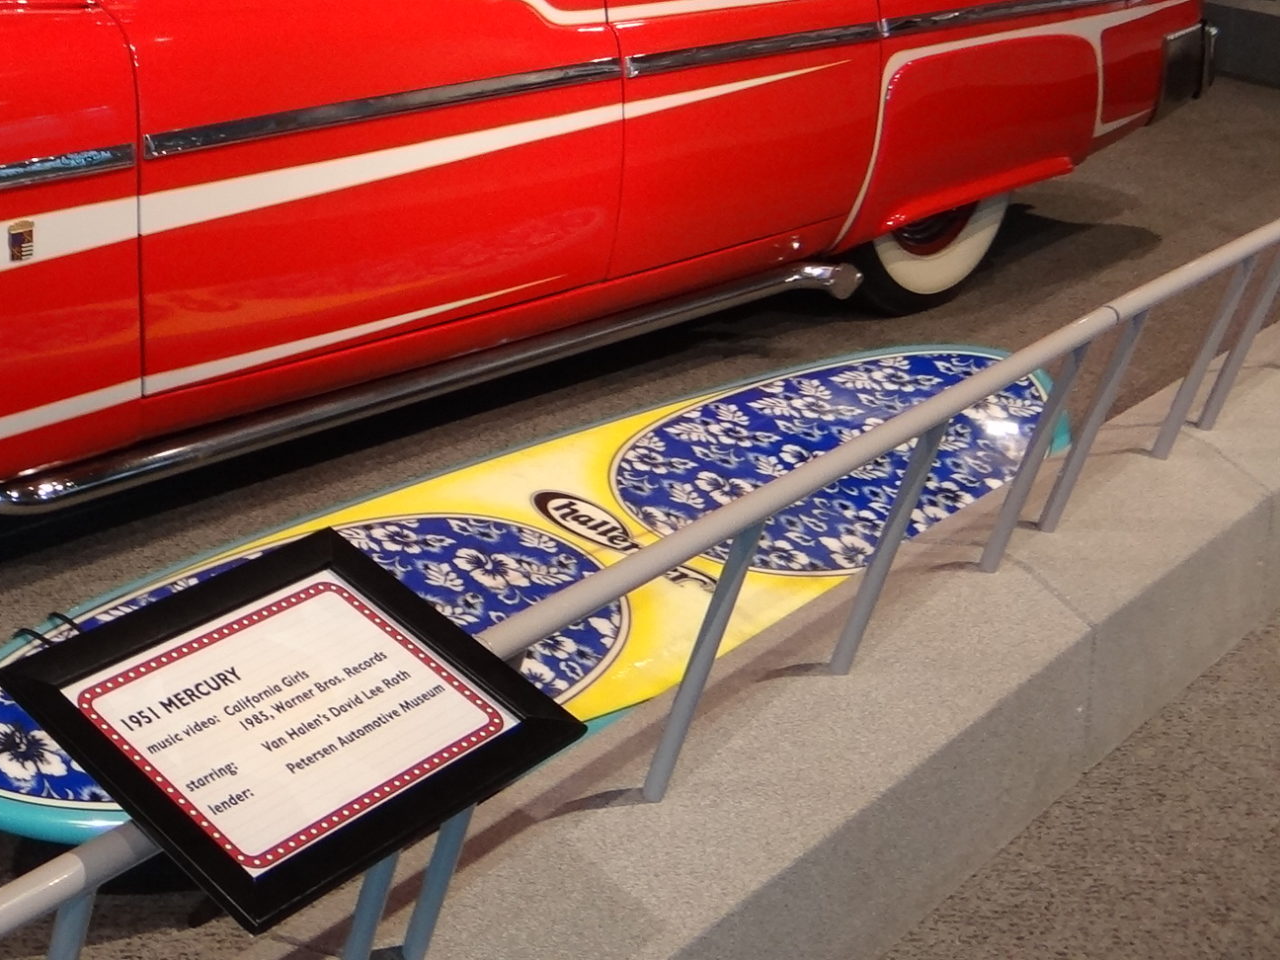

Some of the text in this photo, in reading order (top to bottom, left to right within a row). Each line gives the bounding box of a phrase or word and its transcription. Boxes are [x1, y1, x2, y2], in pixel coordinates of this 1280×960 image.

[120, 666, 242, 732] 1951 MERCURY
[146, 670, 310, 755] music video: California Girls
[185, 669, 412, 792] starring: Van Halen's David Lee Roth
[239, 651, 388, 731] 1985, Warner Bros. Records
[207, 683, 446, 815] lender: Petersen Automotive Museum
